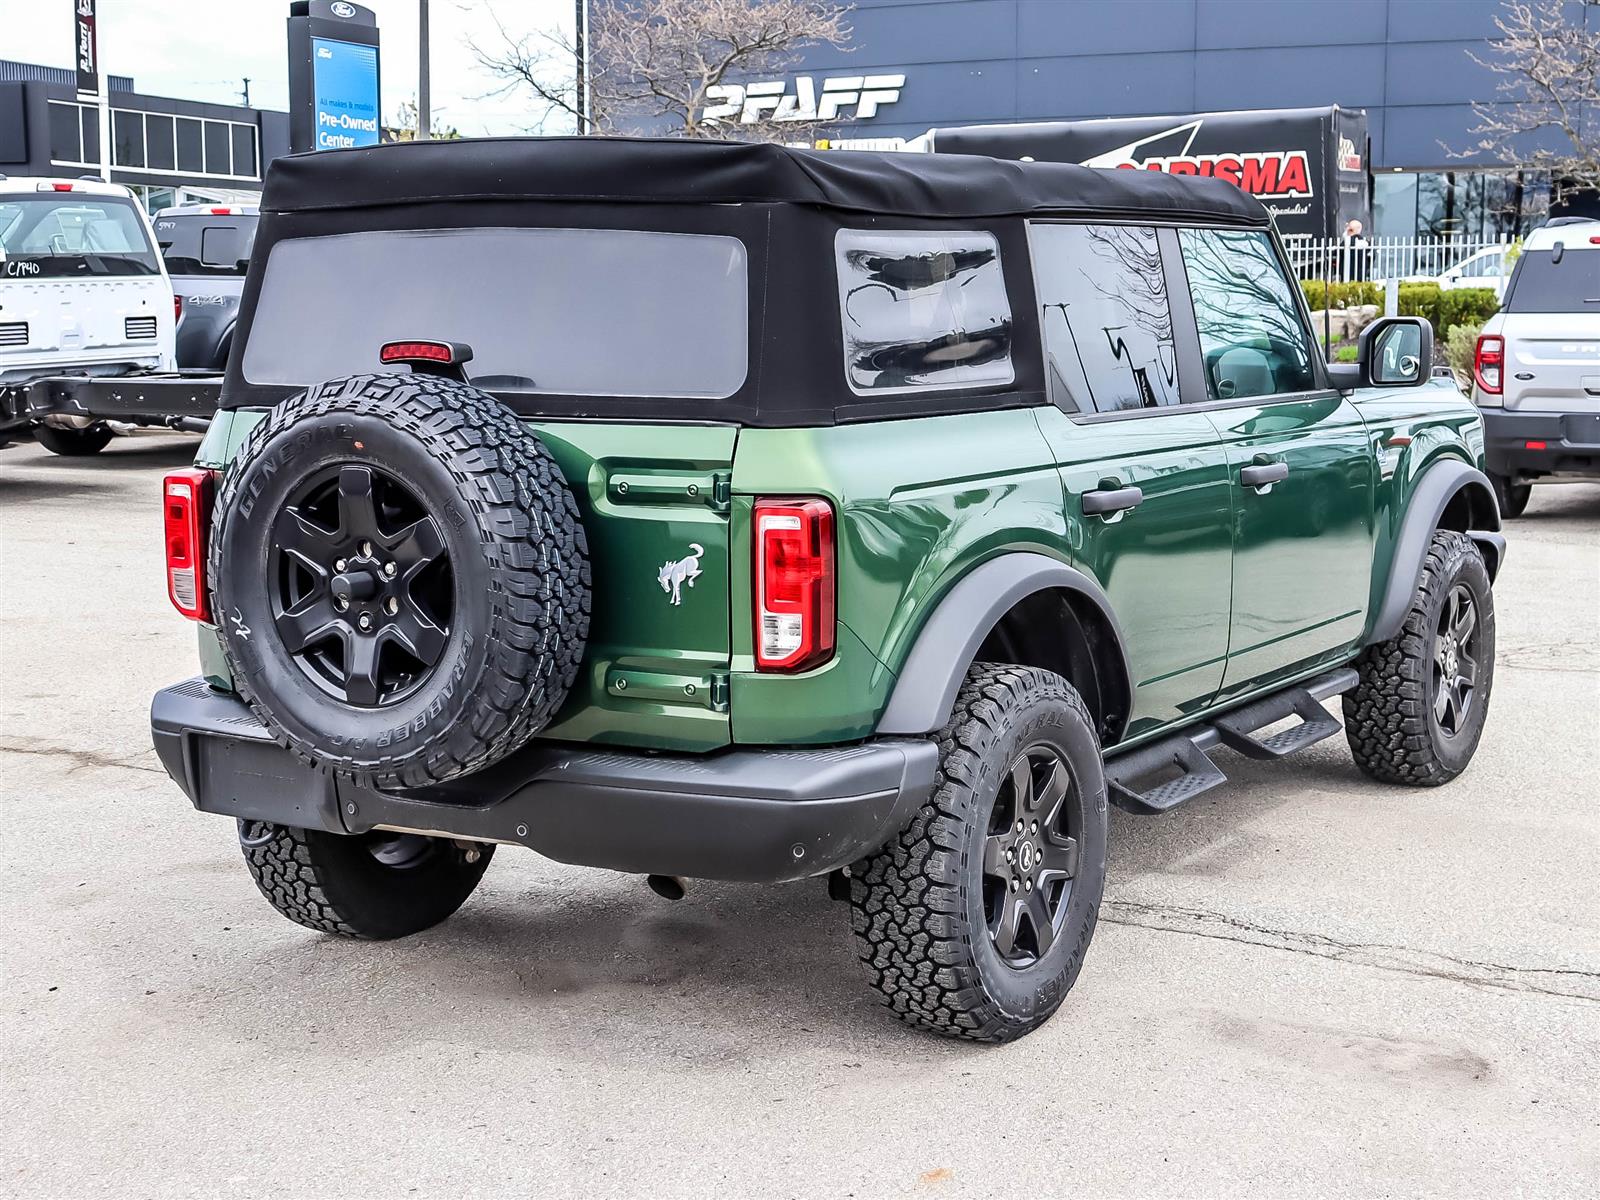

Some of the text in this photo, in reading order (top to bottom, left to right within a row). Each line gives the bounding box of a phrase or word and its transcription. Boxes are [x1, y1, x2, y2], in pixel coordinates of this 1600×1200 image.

[319, 111, 376, 132] Pre-Owned
[319, 131, 355, 148] Center
[240, 423, 355, 520] GENERAL
[376, 630, 474, 748] GRABBER
